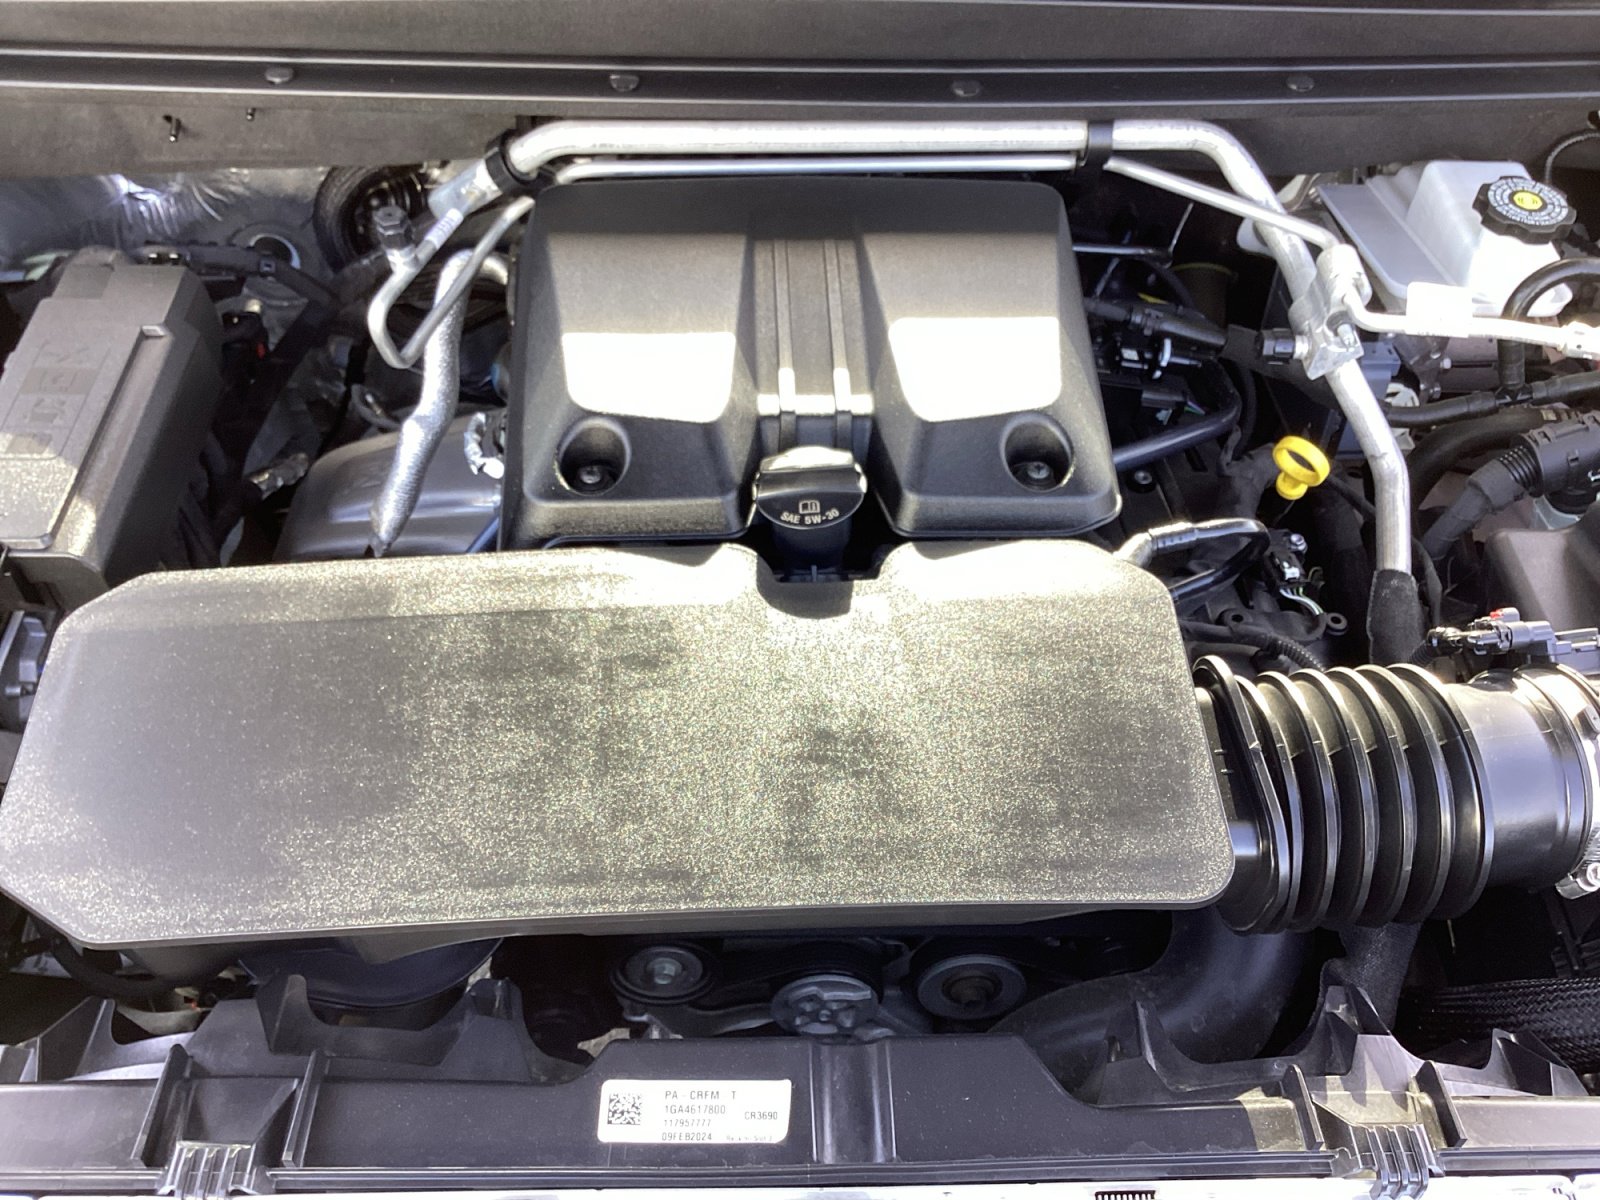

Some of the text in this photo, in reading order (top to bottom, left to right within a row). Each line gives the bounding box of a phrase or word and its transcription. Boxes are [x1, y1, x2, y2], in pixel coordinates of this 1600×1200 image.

[780, 508, 840, 525] SAE 5W-30
[665, 1090, 678, 1100] PA
[690, 1090, 720, 1100] CRFM
[731, 1090, 737, 1100] T
[664, 1104, 726, 1115] 1GA4617800
[744, 1111, 778, 1120] CR3690
[662, 1132, 712, 1141] 09FEB2024
